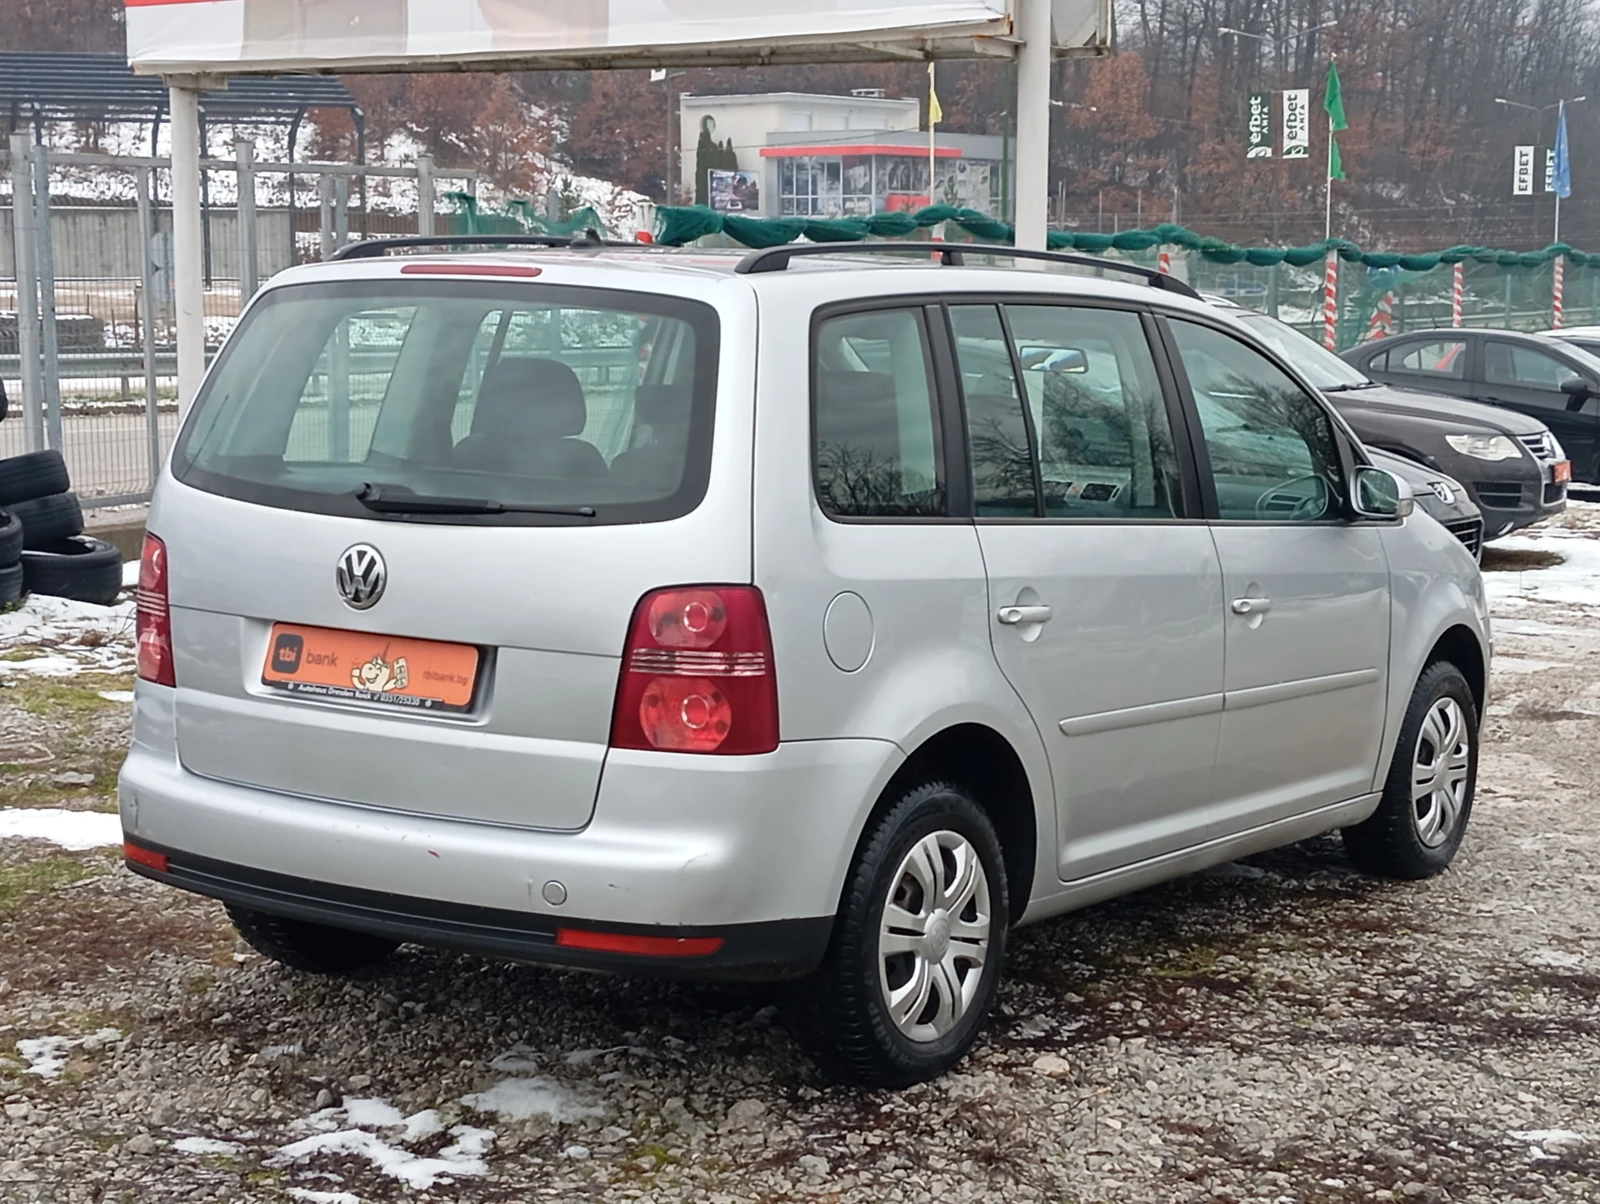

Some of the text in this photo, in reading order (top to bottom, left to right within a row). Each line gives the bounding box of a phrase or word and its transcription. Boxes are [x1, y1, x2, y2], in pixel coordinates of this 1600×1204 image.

[1249, 95, 1261, 143] efbet
[1286, 93, 1298, 141] efbet
[1519, 150, 1529, 192] EFBET
[279, 646, 339, 667] tbi bank
